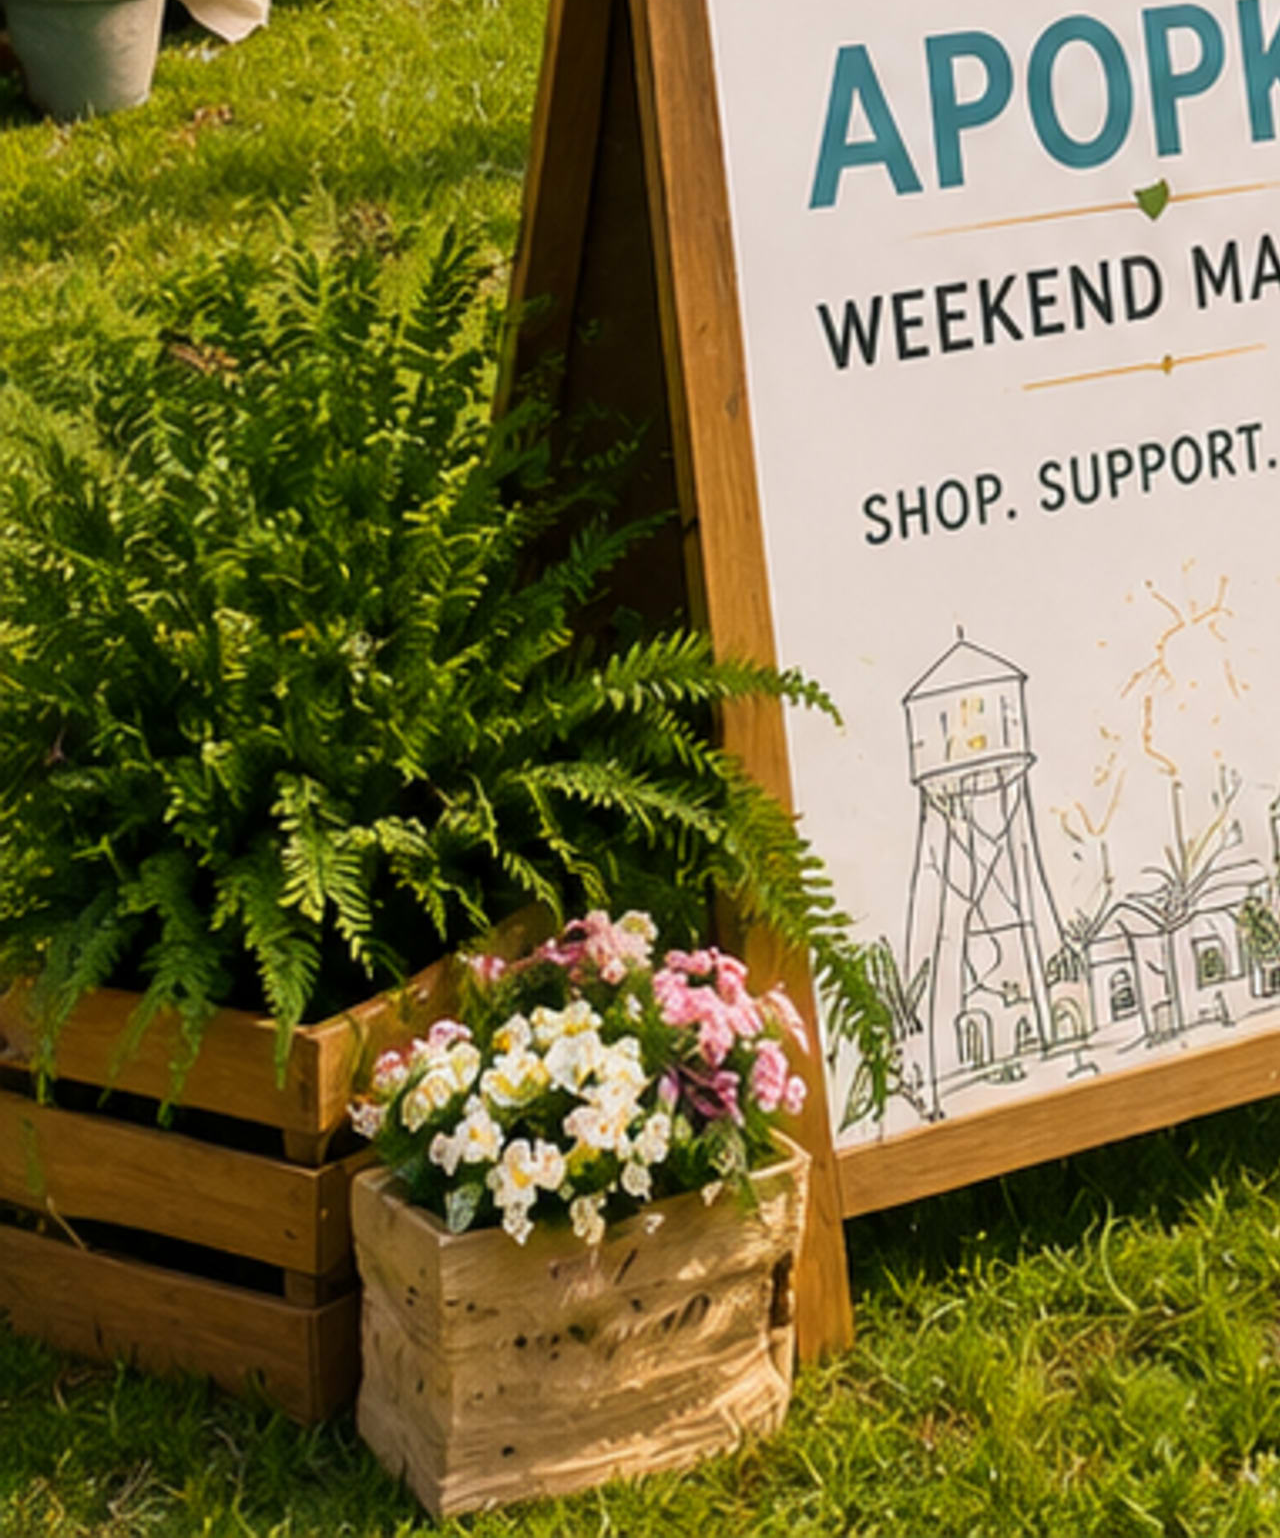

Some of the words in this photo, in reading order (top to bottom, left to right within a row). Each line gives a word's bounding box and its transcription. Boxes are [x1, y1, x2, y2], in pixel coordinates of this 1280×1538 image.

[818, 256, 1162, 369] WEEKEND
[864, 474, 1015, 544] SHOP.
[1040, 423, 1276, 511] SUPPORT.
